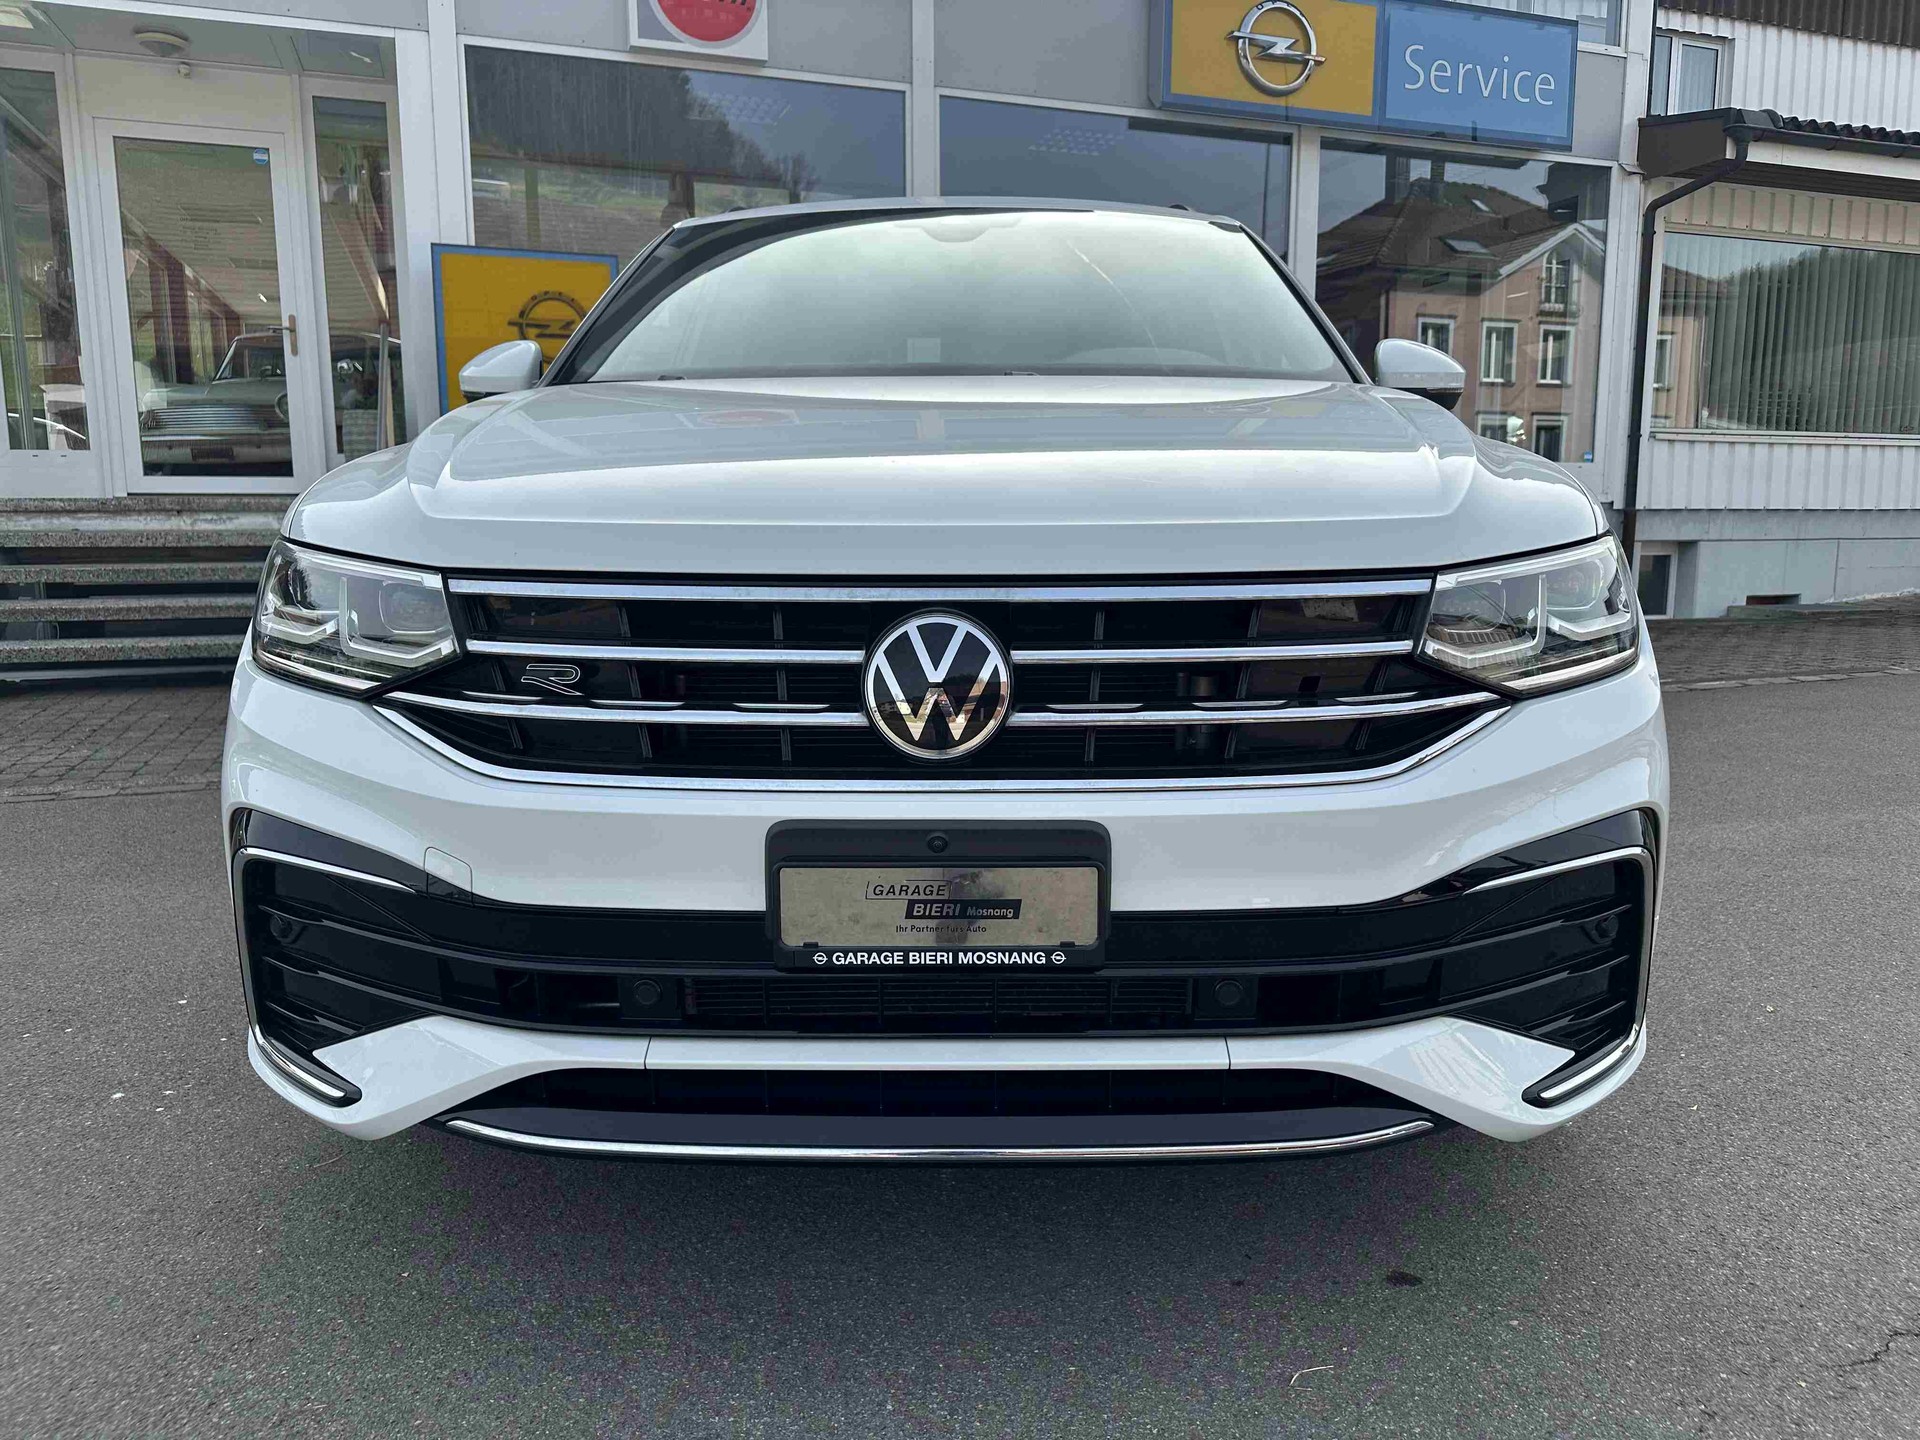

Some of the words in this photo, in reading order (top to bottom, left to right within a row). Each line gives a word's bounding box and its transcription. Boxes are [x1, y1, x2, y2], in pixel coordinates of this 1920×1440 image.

[1403, 44, 1556, 106] Service
[872, 884, 947, 897] GARAGE
[912, 903, 961, 916] BIERI
[966, 906, 1014, 918] Mosnang
[895, 925, 907, 933] Ihr
[910, 925, 944, 933] Partner
[966, 925, 987, 933] Auto
[832, 952, 904, 965] GARAGE
[908, 952, 952, 965] BIERI
[958, 952, 1046, 965] MOSNANG
